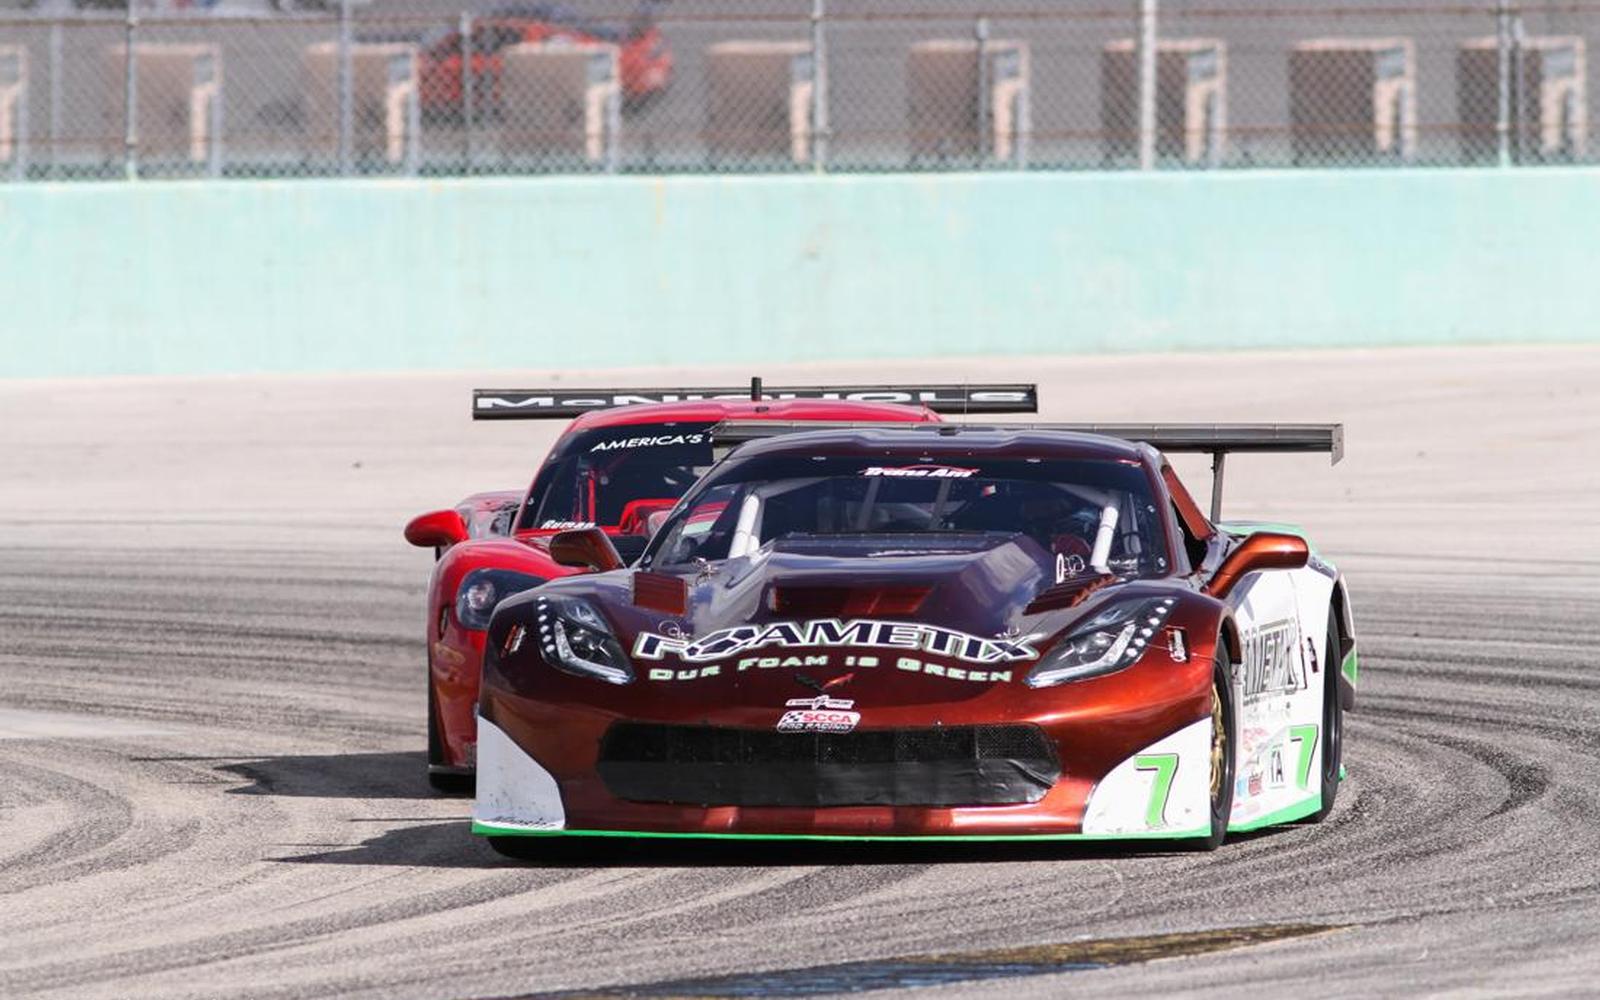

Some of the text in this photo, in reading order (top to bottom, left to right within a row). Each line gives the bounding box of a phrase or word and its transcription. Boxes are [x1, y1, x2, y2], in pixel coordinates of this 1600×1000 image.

[589, 433, 704, 453] AMERICA'S
[926, 468, 974, 478] Am
[648, 654, 1014, 683] OUR FOAM IS GREEN
[802, 713, 852, 724] SCCA
[1287, 723, 1319, 791] 7
[1133, 752, 1181, 829] 7
